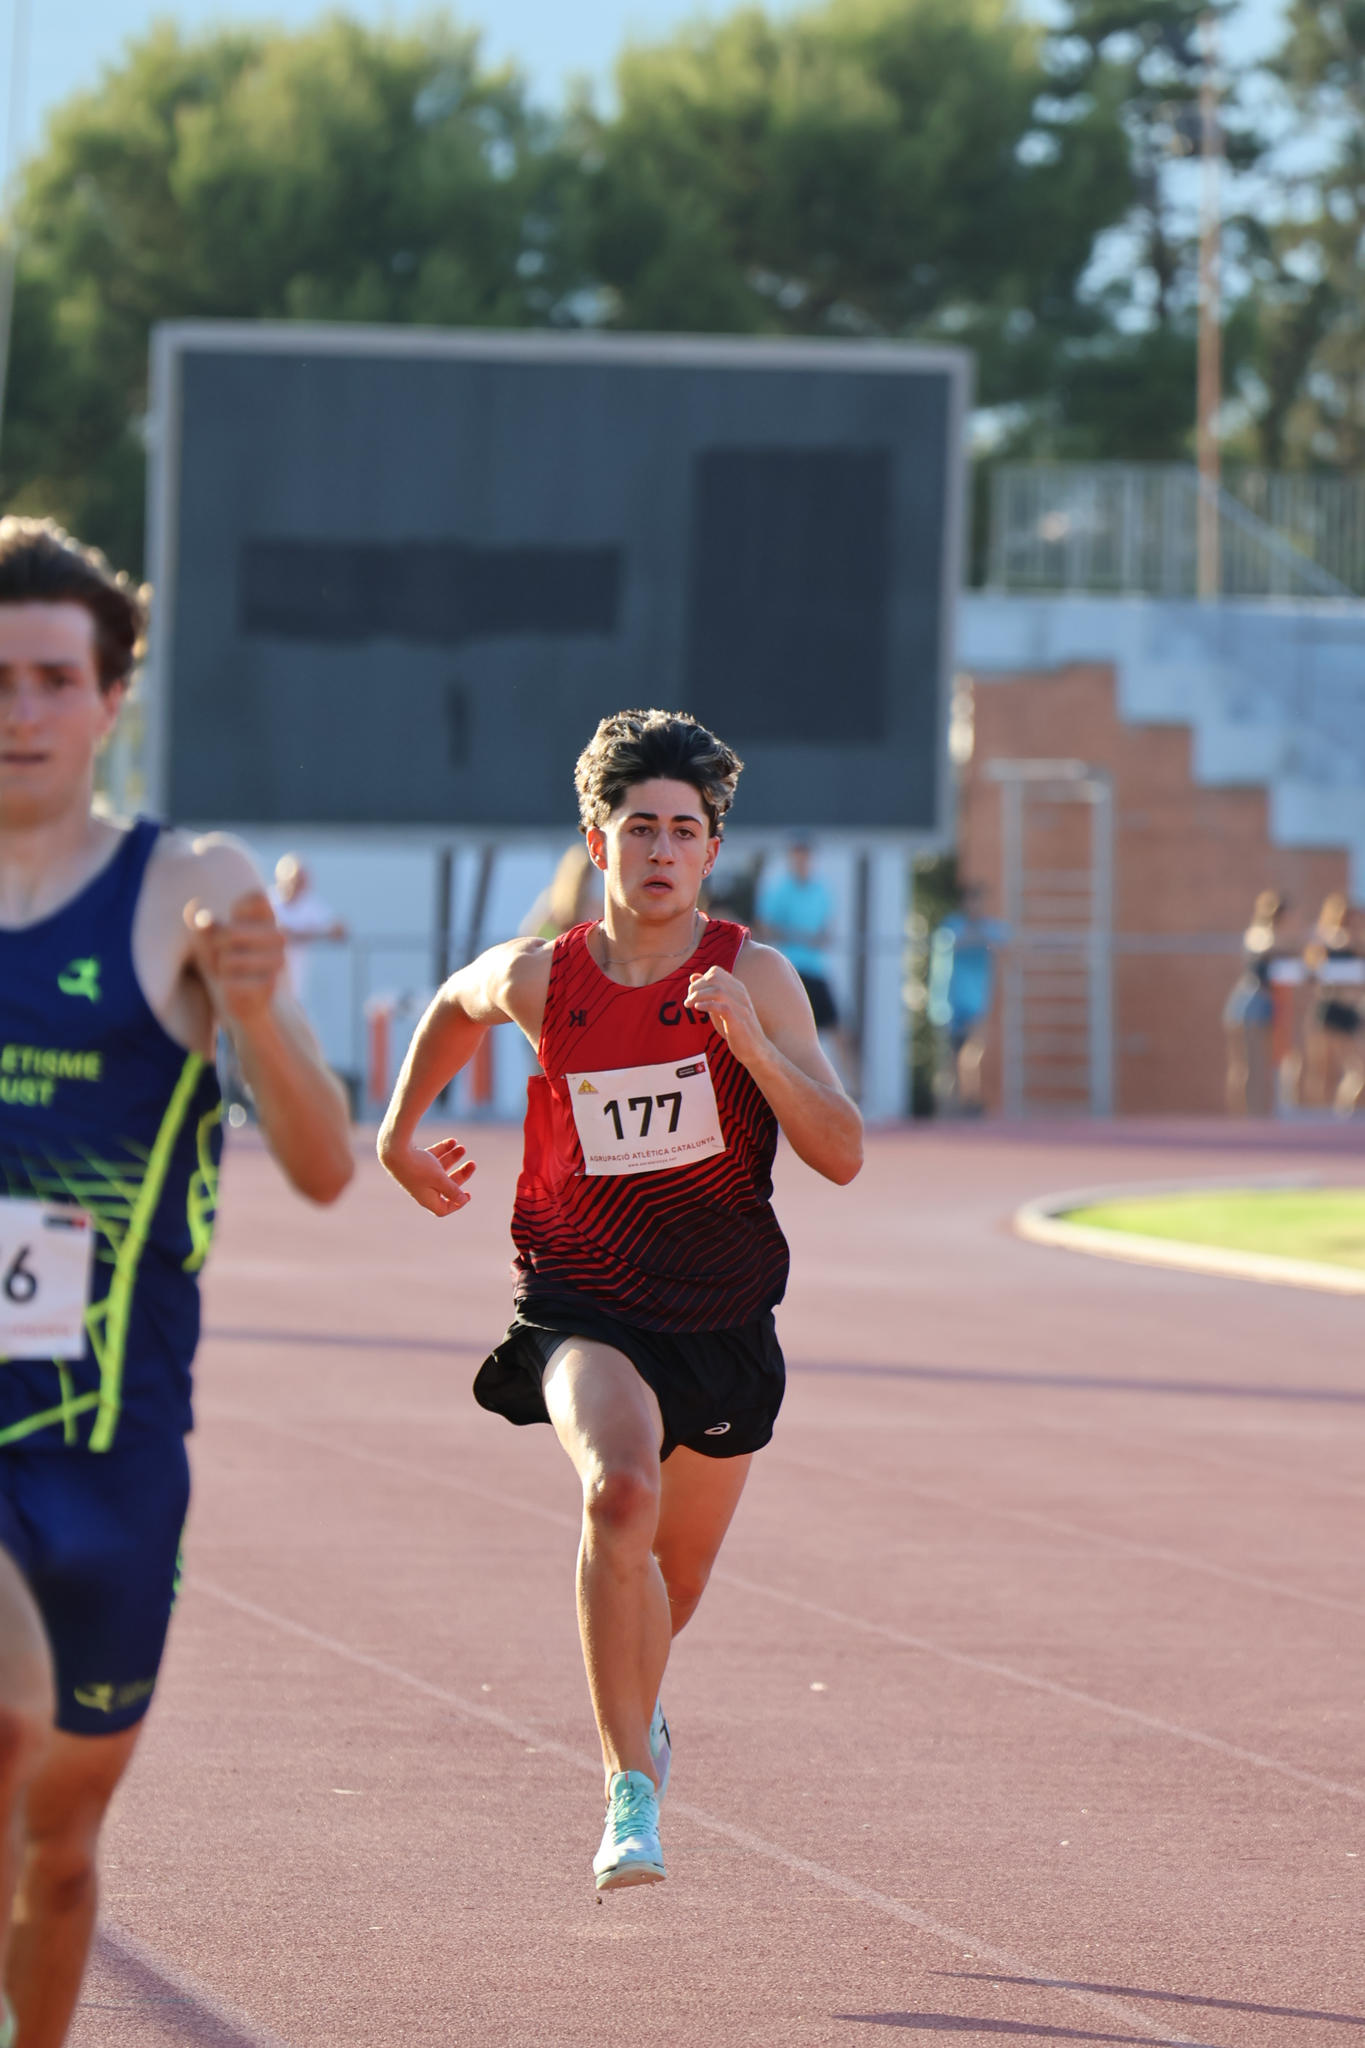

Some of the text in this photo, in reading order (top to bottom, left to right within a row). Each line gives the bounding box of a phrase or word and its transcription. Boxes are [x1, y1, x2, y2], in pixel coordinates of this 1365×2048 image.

[603, 1091, 683, 1140] 177
[589, 1152, 631, 1163] AGRUPACIÓ
[671, 1135, 716, 1153] CATALUNYA
